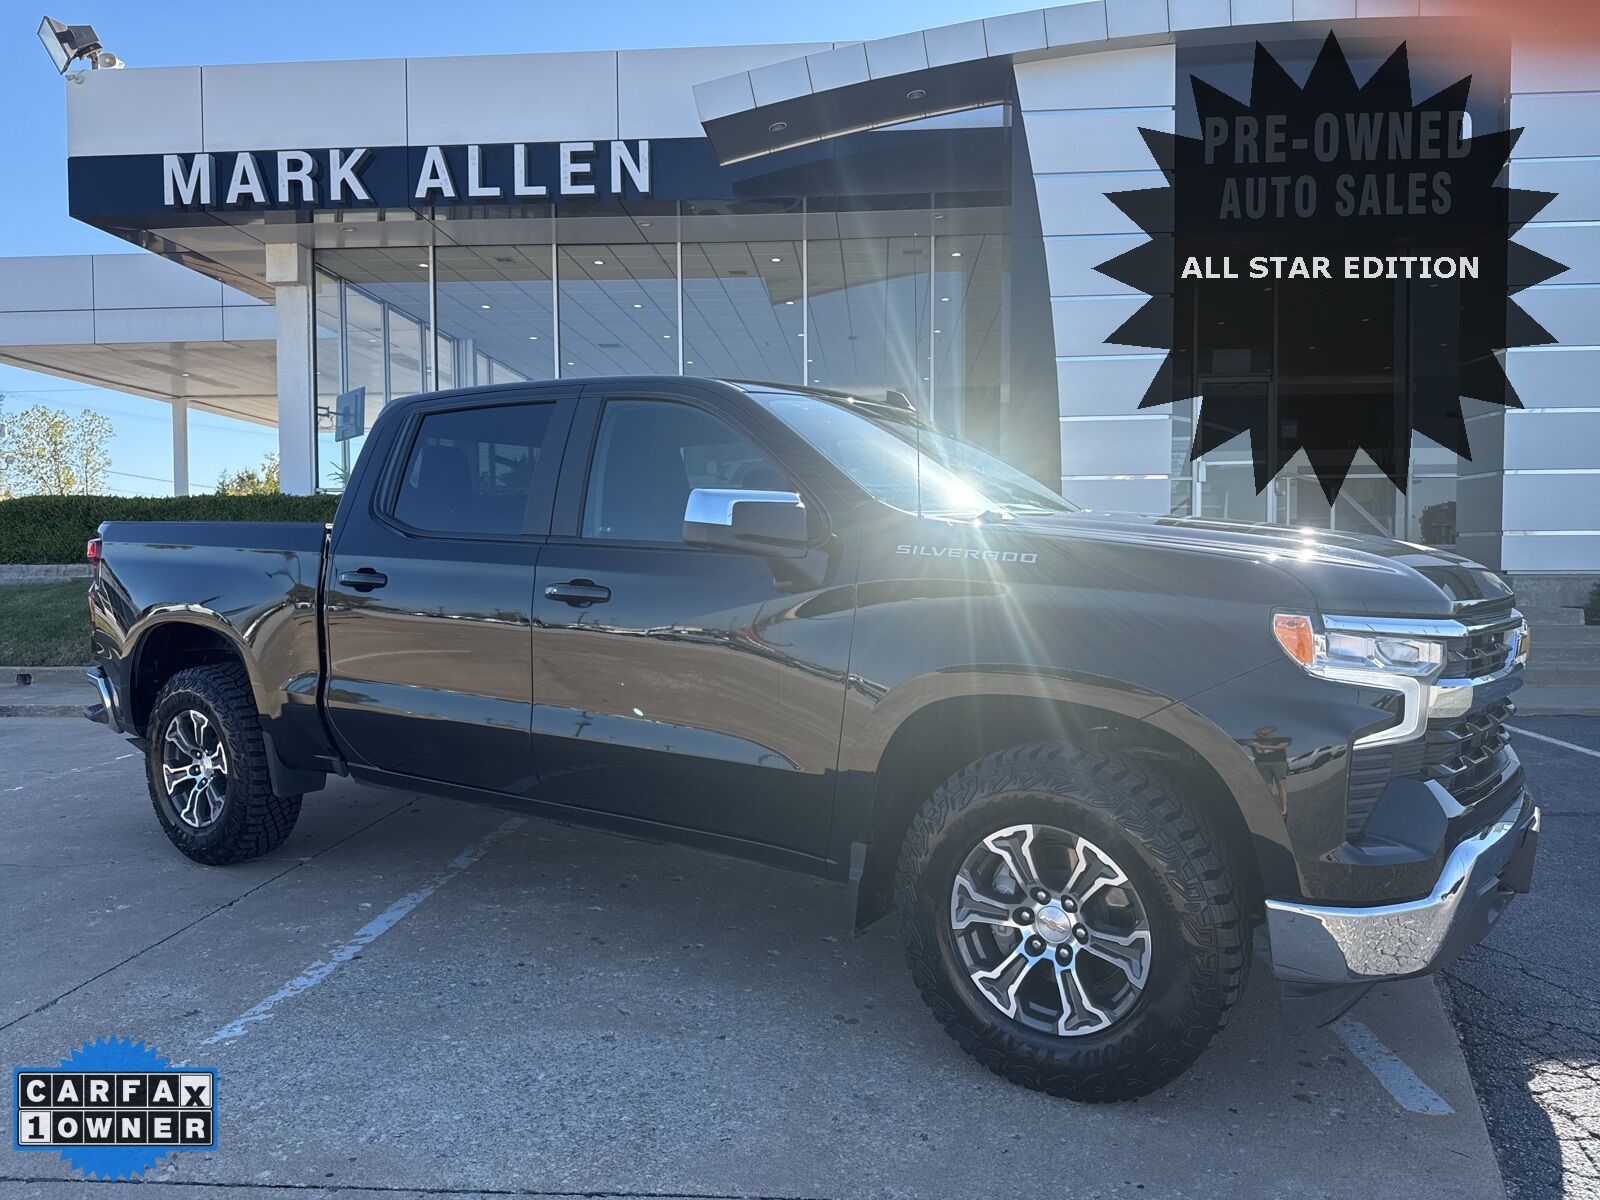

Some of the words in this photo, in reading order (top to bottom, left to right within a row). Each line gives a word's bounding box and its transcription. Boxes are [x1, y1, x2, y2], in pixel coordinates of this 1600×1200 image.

[1203, 110, 1473, 165] PRE-OWNED
[163, 147, 372, 206] MARK
[414, 139, 651, 199] ALLEN
[1219, 174, 1317, 221] AUTO
[1335, 170, 1453, 218] SALES
[895, 544, 1038, 563] SILVERADO
